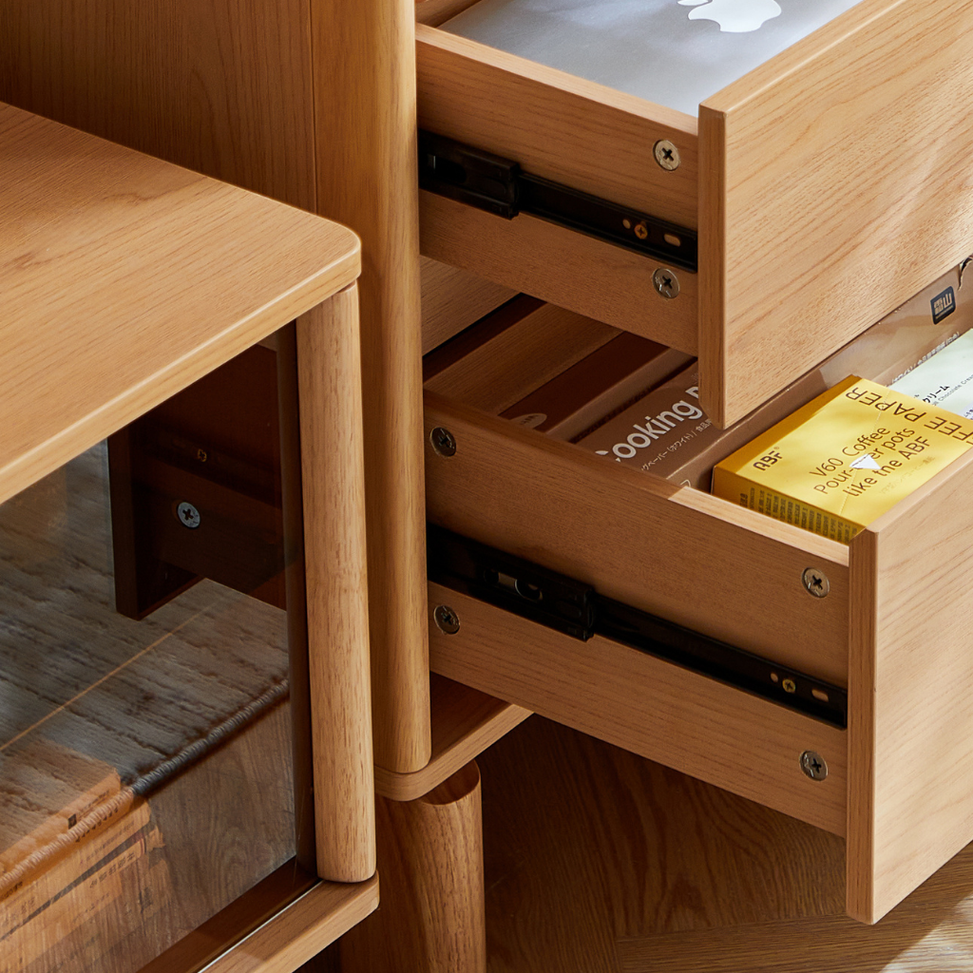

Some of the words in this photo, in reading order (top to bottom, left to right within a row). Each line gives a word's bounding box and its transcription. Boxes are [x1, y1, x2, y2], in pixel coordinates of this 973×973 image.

[595, 399, 703, 463] ooking
[846, 387, 927, 422] PAPER
[809, 457, 844, 478] V60
[842, 427, 891, 457] Coffee
[813, 442, 885, 494] Pour-er
[881, 428, 916, 452] pots
[843, 476, 878, 497] like
[898, 435, 931, 461] ABF
